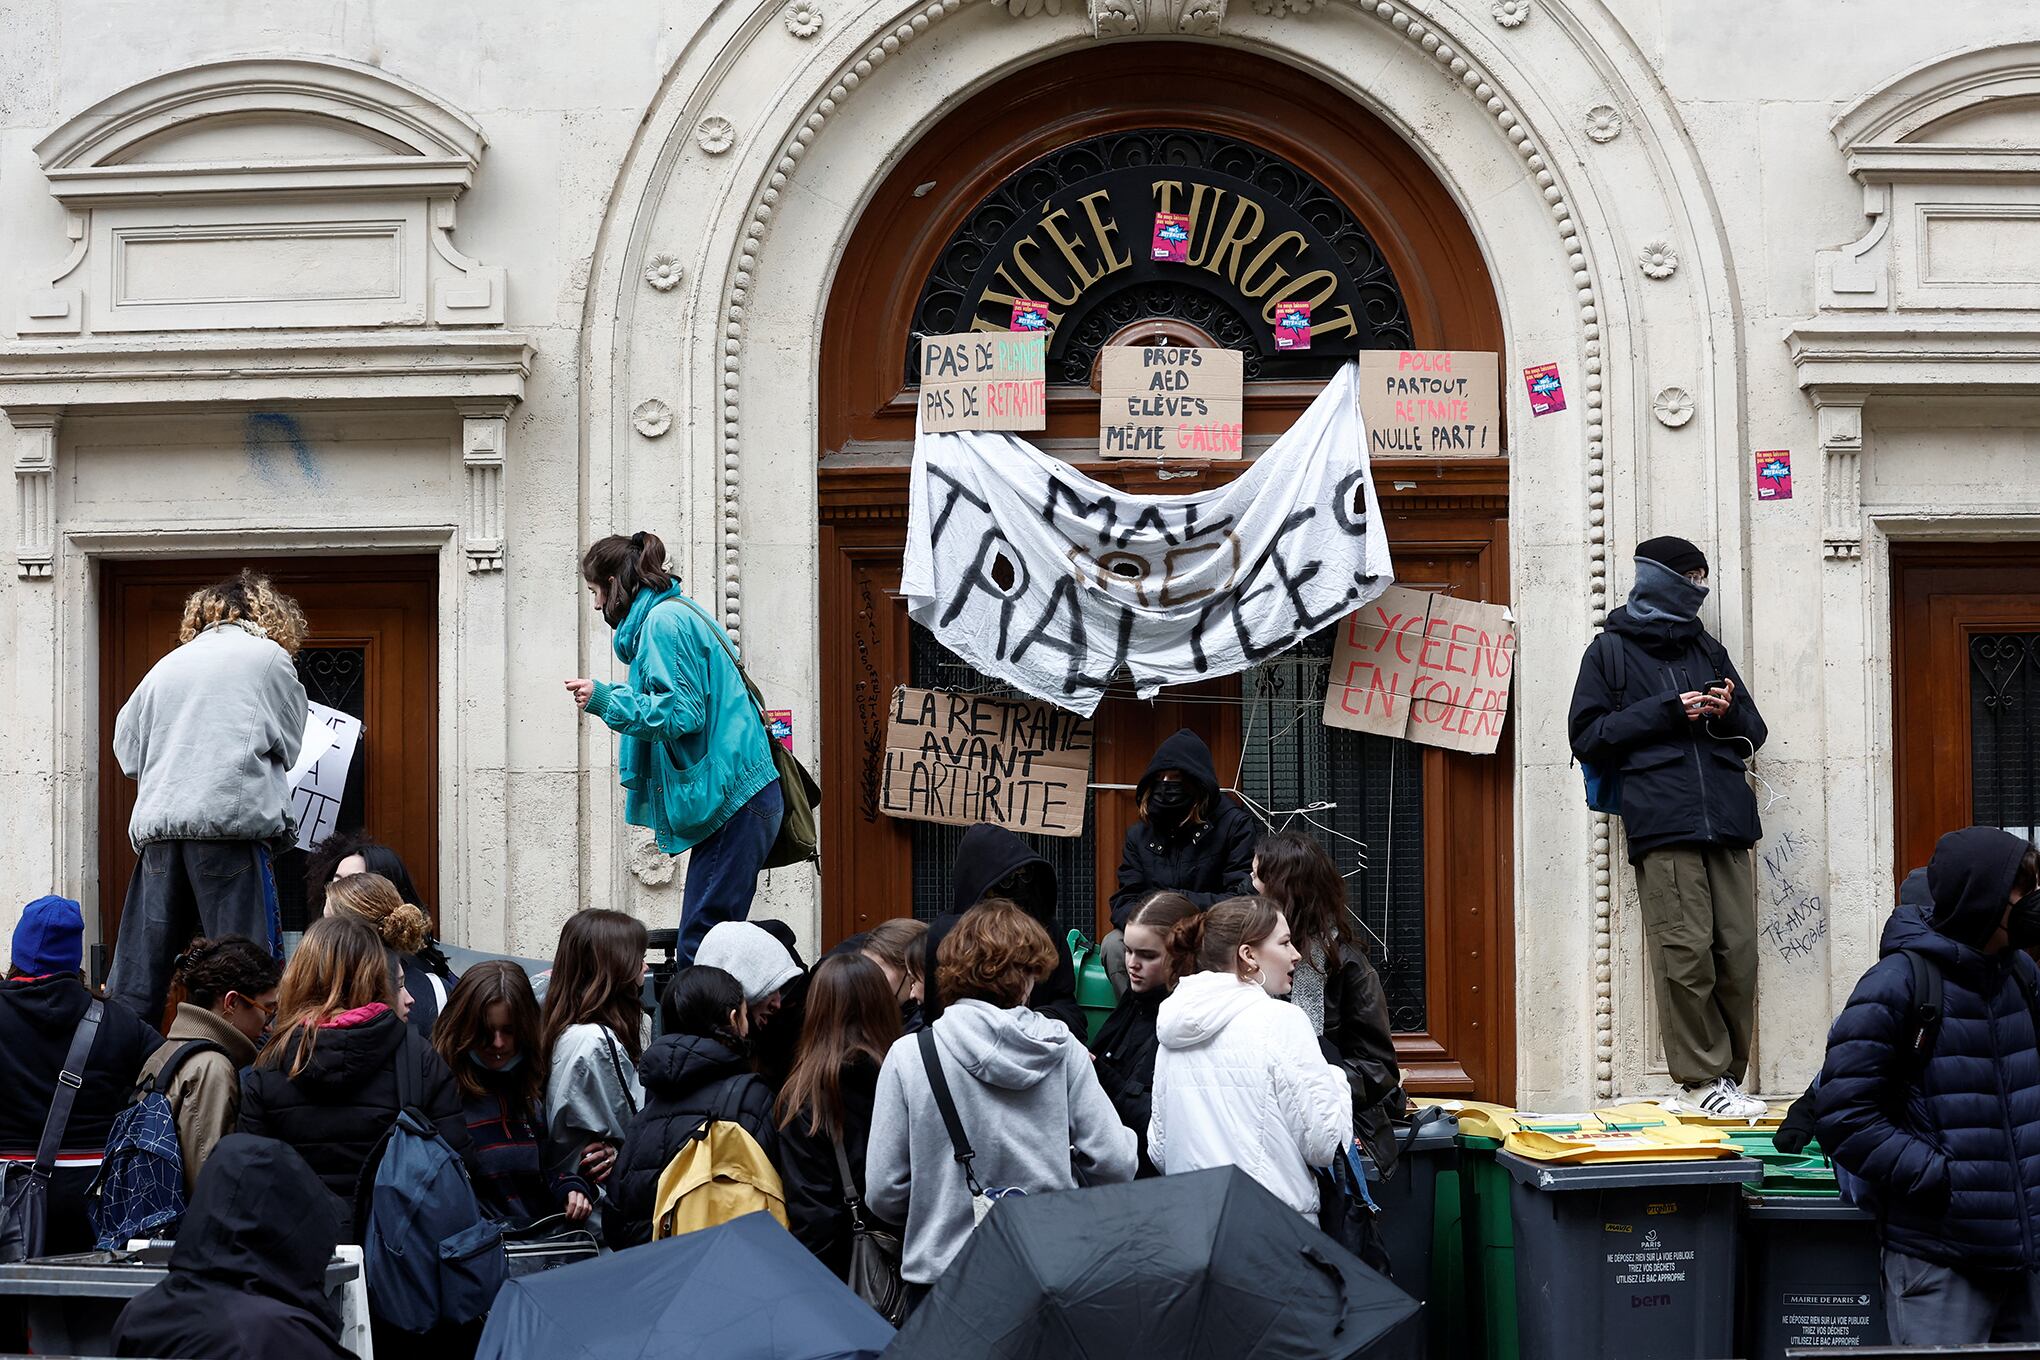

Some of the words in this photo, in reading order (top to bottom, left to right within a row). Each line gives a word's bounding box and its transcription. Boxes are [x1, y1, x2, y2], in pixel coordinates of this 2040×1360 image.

[970, 189, 1133, 352] YCÉE
[925, 343, 969, 377] PAS
[975, 342, 993, 372] DE
[1143, 348, 1202, 367] PROFS
[1398, 351, 1452, 373] POLICE
[1149, 369, 1189, 391] AED
[1386, 376, 1468, 398] PARTOUT,
[926, 389, 955, 421] PAS
[962, 386, 979, 418] DE
[987, 381, 1046, 417] RETRAITE
[1395, 399, 1469, 422] RETRAITE
[1106, 422, 1166, 451] MÊME
[1372, 426, 1422, 452] NULLE
[1432, 425, 1475, 451] PART
[1043, 475, 1233, 548] MAL
[1348, 606, 1516, 678] LYCEENS
[1341, 661, 1399, 718] EN
[1409, 675, 1508, 737] COLERE
[896, 688, 937, 728] LA
[947, 694, 1093, 751] RETRAITE
[920, 731, 1044, 777] AVANT
[883, 751, 1068, 829] L'ARTHRITE
[1763, 831, 1803, 879] NIK
[1771, 879, 1795, 906] LA
[1779, 918, 1826, 964] PHOBIE
[1607, 1254, 1614, 1262] NE
[1614, 1252, 1635, 1262] DÉPOSEZ
[1636, 1253, 1646, 1262] RIEN
[1646, 1253, 1656, 1262] SUR
[1656, 1252, 1662, 1261] LA
[1662, 1252, 1673, 1260] VOIE
[1674, 1250, 1694, 1260] PUBLIQUE
[1628, 1264, 1642, 1272] TRIEZ
[1643, 1264, 1652, 1272] VOS
[1653, 1260, 1675, 1272] DÉCHETS
[1616, 1275, 1638, 1284] UTILISEZ
[1639, 1275, 1645, 1283] LE
[1646, 1274, 1657, 1283] BAC
[1658, 1270, 1686, 1282] APPROPRIÉ
[1631, 1294, 1671, 1308] bern
[1789, 1314, 1809, 1324] DÉPOSEZ
[1837, 1316, 1847, 1324] VOIE
[1848, 1316, 1869, 1325] PUBLIQUE
[1827, 1325, 1849, 1335] DÉCHETS
[1790, 1336, 1812, 1345] UTILISEZ
[1813, 1337, 1819, 1345] LE
[1820, 1337, 1832, 1345] BAC
